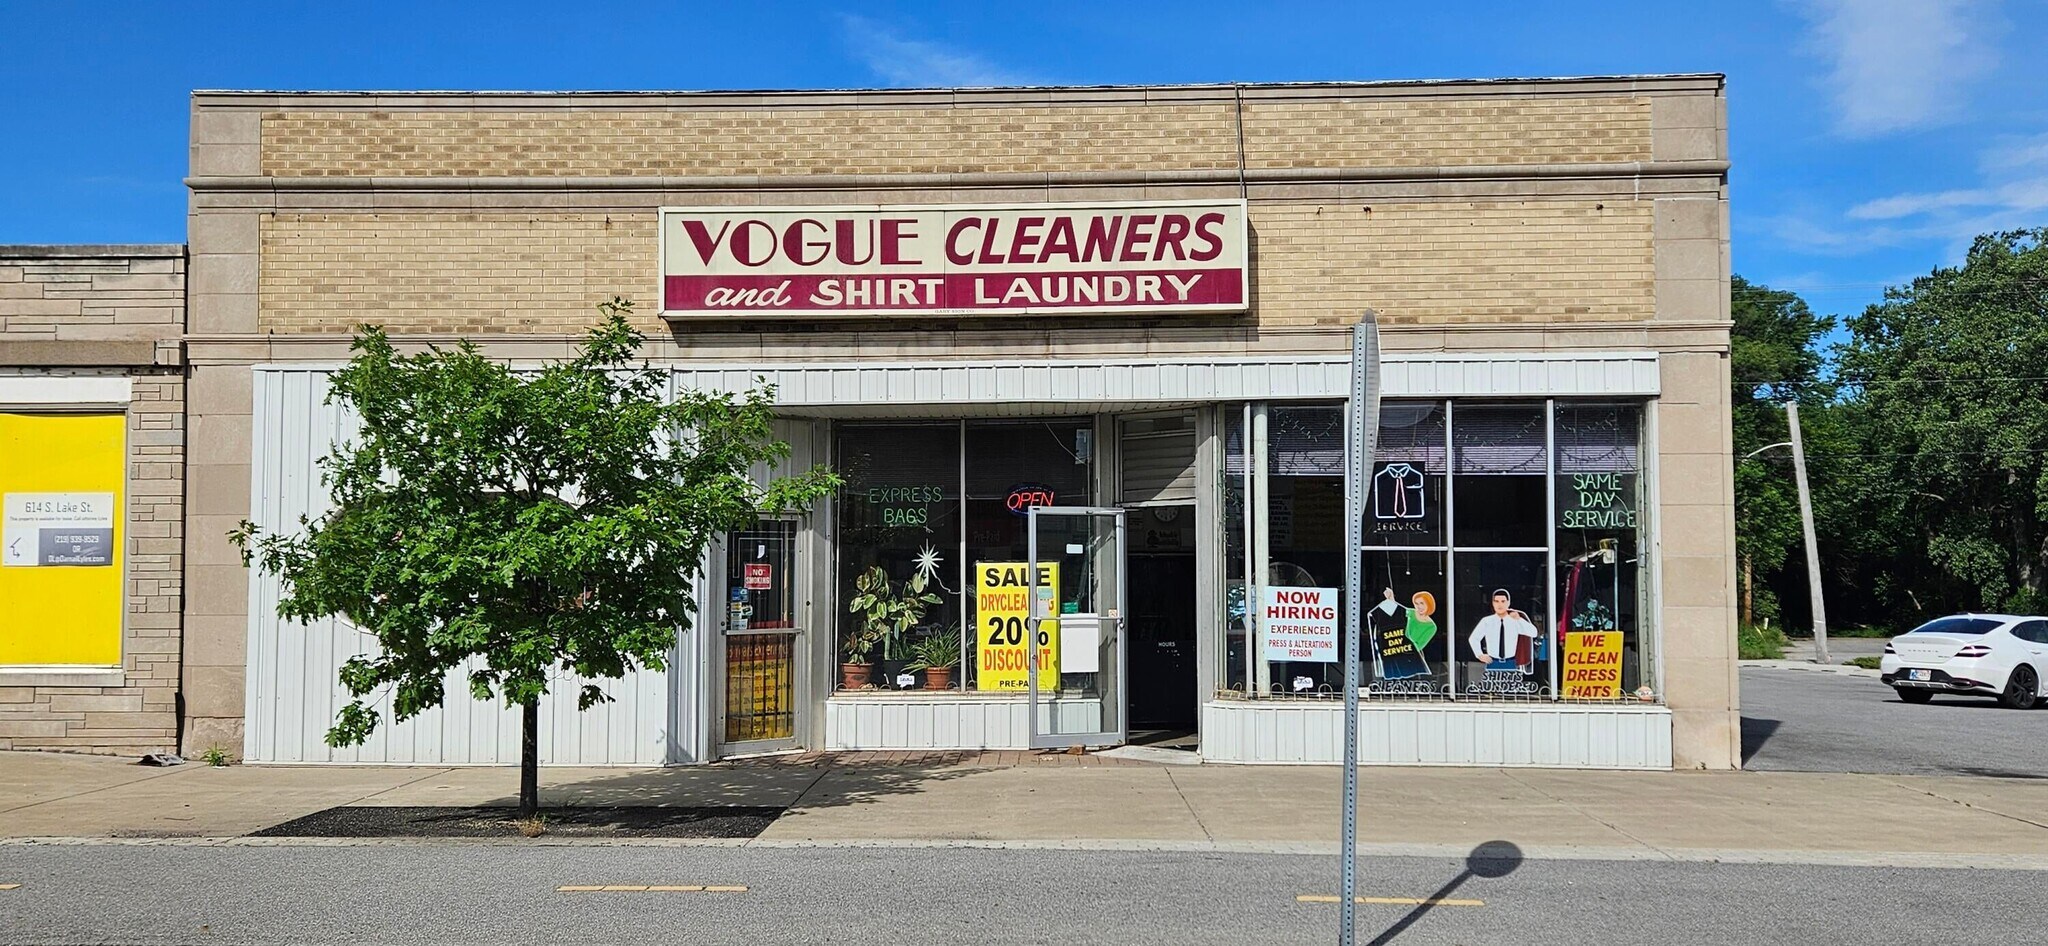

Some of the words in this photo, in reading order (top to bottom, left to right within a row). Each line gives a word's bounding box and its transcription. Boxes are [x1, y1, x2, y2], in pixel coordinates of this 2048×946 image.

[681, 218, 923, 267] VOGUE
[944, 212, 1225, 266] CLEANERS
[704, 280, 792, 308] and
[809, 278, 944, 306] SHIRT
[975, 274, 1203, 305] LAUNDRY
[1573, 473, 1623, 491] SAME
[869, 486, 943, 503] EXPRESS
[1006, 491, 1055, 510] OPEN
[1580, 491, 1616, 508] DAY
[25, 502, 42, 513] 614
[45, 502, 54, 513] S.
[56, 502, 78, 513] Lake
[80, 502, 93, 513] St.
[884, 507, 928, 524] BAGS
[1563, 510, 1637, 528] SERVICE
[1376, 521, 1424, 532] SERVICE
[54, 535, 69, 544] (219)
[72, 545, 81, 553] OR
[745, 576, 770, 584] SMOKING
[985, 567, 1051, 587] SALE
[1276, 591, 1320, 604] NOW
[1267, 606, 1334, 620] HIRING
[988, 616, 1049, 646] 20%
[1270, 625, 1331, 635] EXPERIENCED
[1383, 629, 1405, 639] SAME
[1268, 639, 1289, 648] PRESS
[1294, 640, 1333, 649] ALTERATIONS
[1388, 638, 1404, 647] DAY
[1582, 635, 1606, 647] WE
[1288, 649, 1312, 657] PERSON
[1383, 644, 1413, 656] SERVICE
[984, 648, 1051, 671] DISCOUNT
[1567, 652, 1619, 665] CLEAN
[1482, 670, 1524, 683] SHIRTS
[1566, 669, 1618, 681] DRESS
[1369, 680, 1437, 694] CLEANERS
[1466, 681, 1539, 694] LAUNDERED
[1571, 685, 1612, 698] HATS
